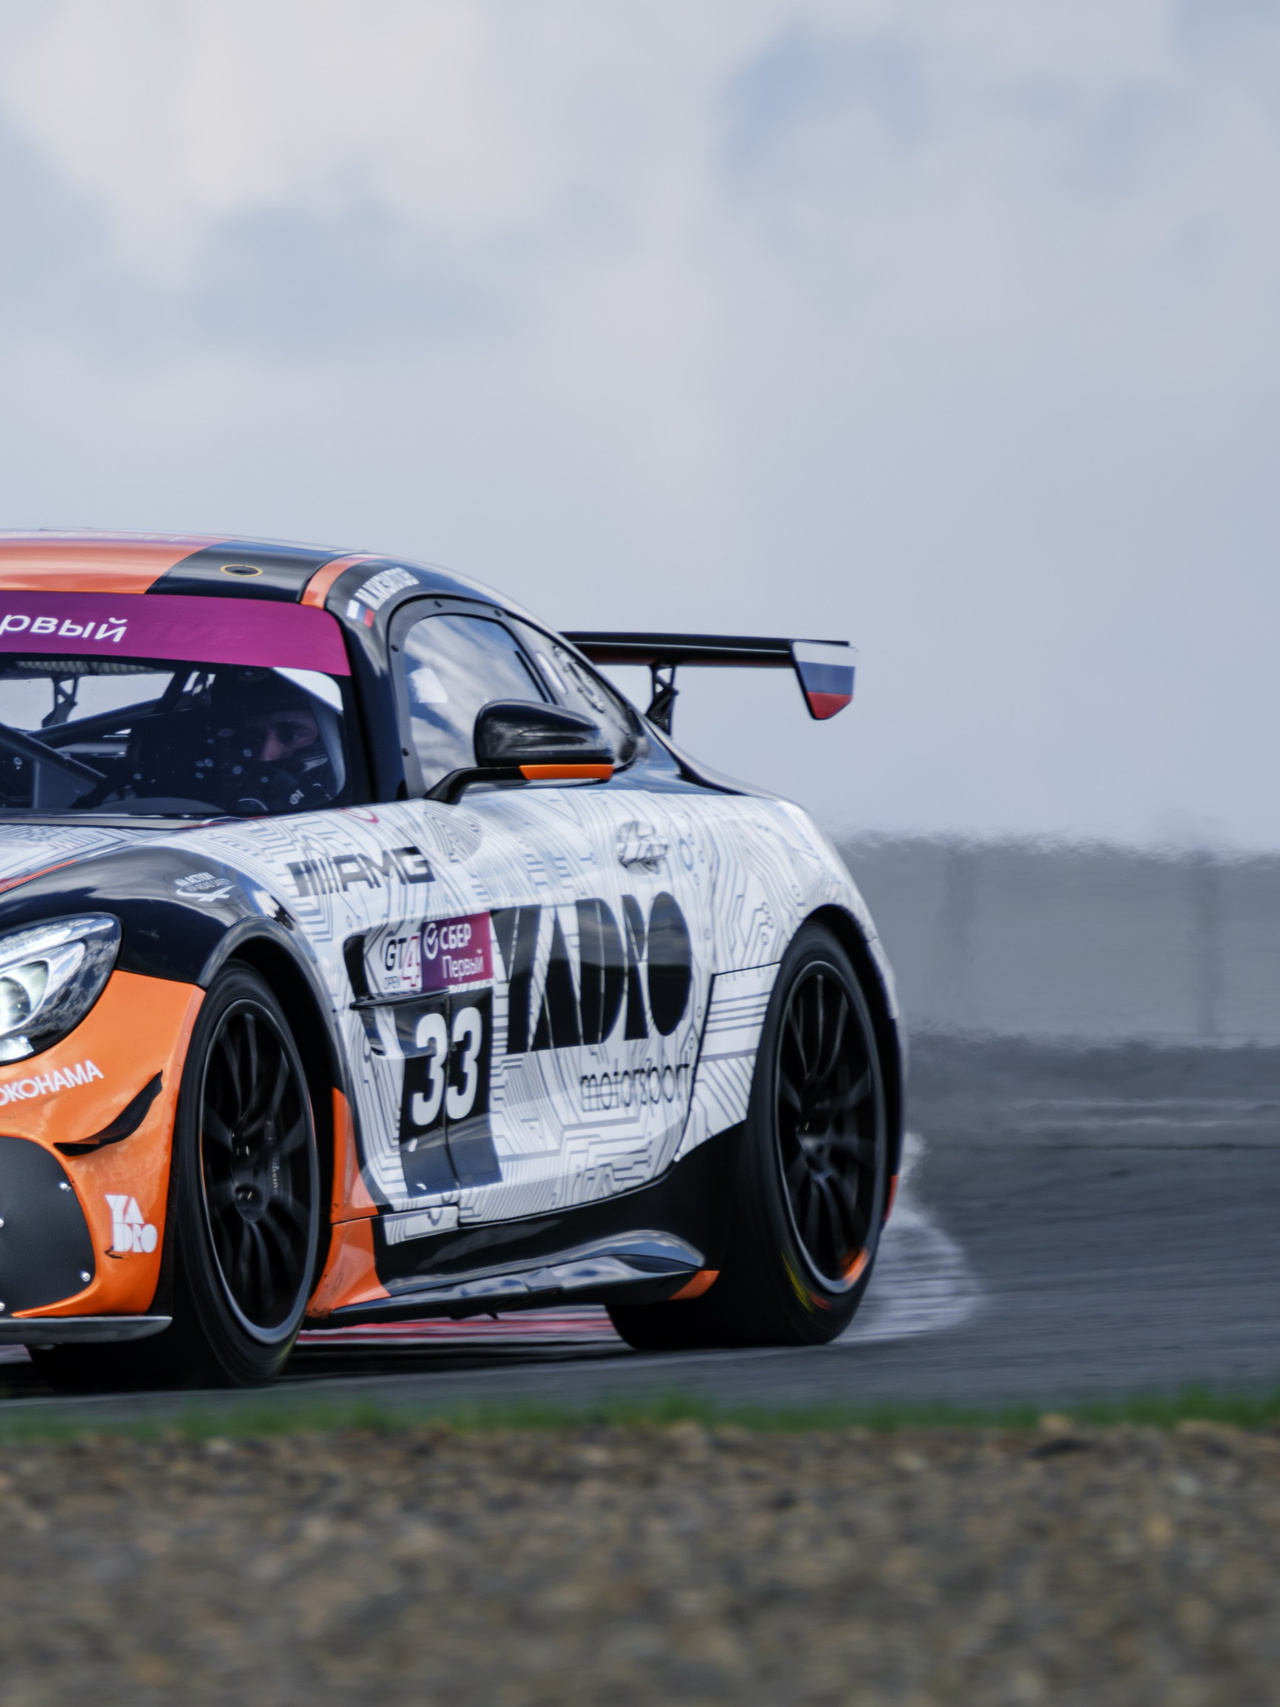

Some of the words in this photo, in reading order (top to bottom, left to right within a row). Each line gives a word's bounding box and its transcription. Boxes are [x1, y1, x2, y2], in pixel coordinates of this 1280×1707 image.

[440, 923, 472, 950] СБЕР
[442, 949, 485, 982] Первый
[412, 1007, 483, 1126] 33
